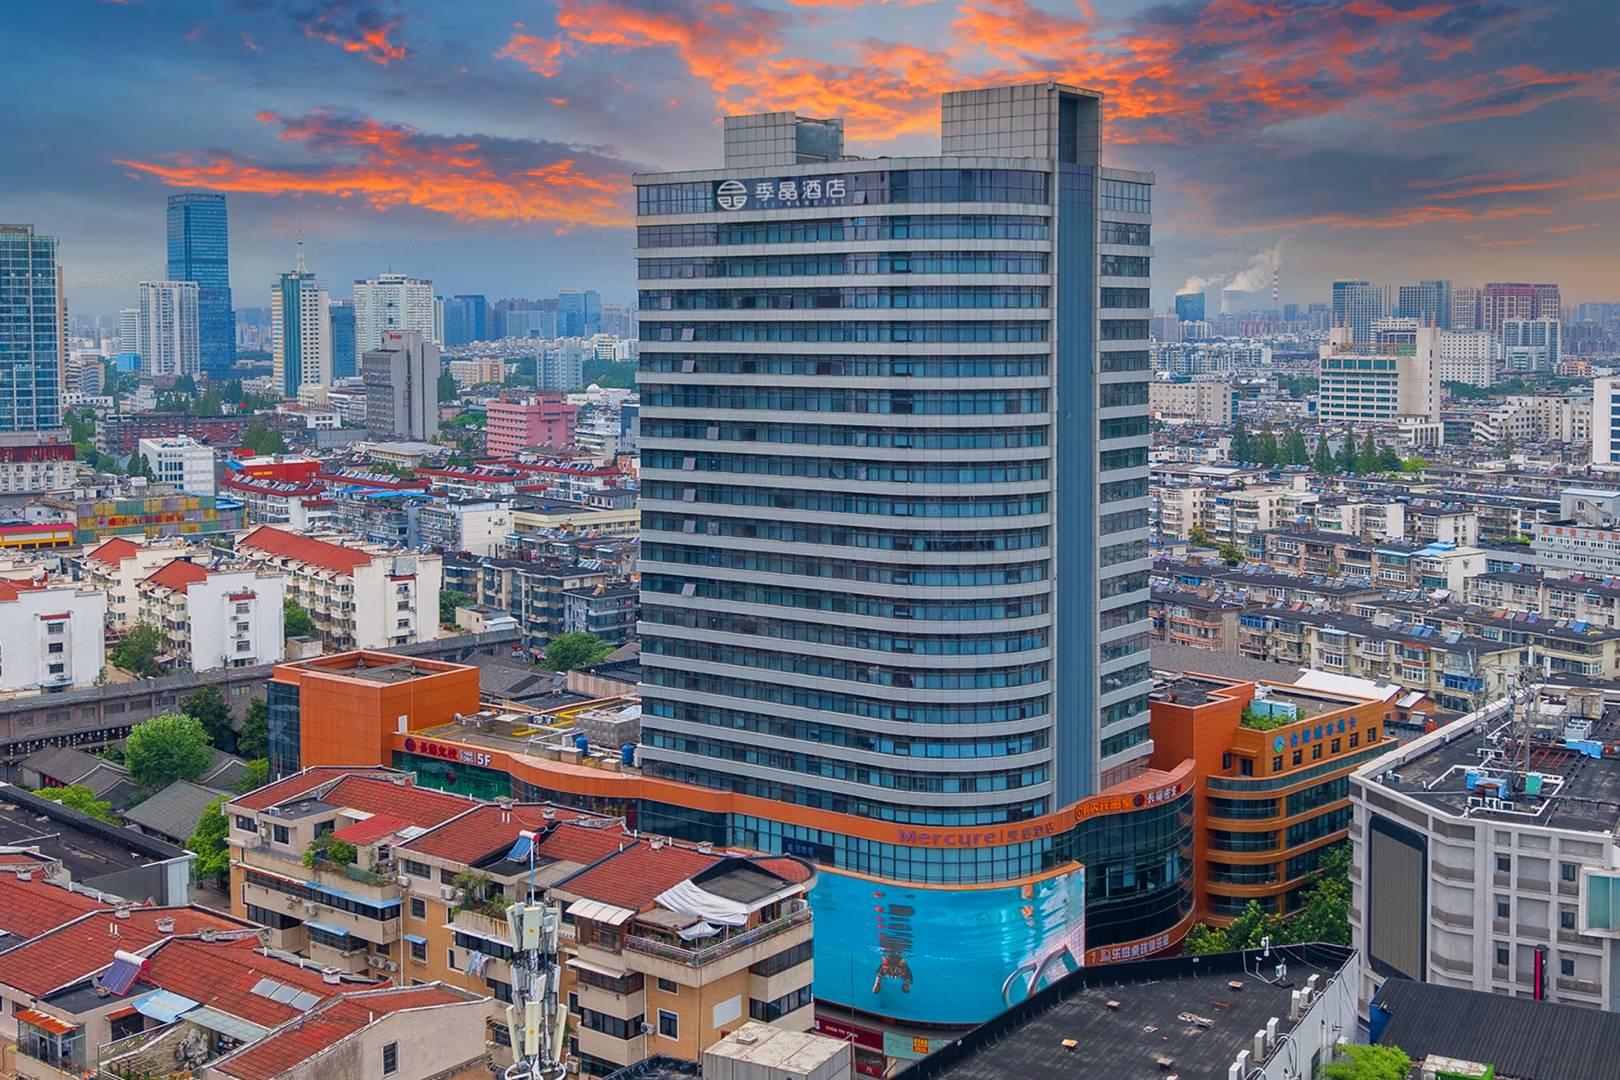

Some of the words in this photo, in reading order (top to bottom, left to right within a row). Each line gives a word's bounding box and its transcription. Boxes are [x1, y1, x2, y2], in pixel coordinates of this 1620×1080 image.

[755, 179, 846, 202] 季晶酒店
[477, 753, 491, 766] 5F
[898, 829, 996, 847] Mercure
